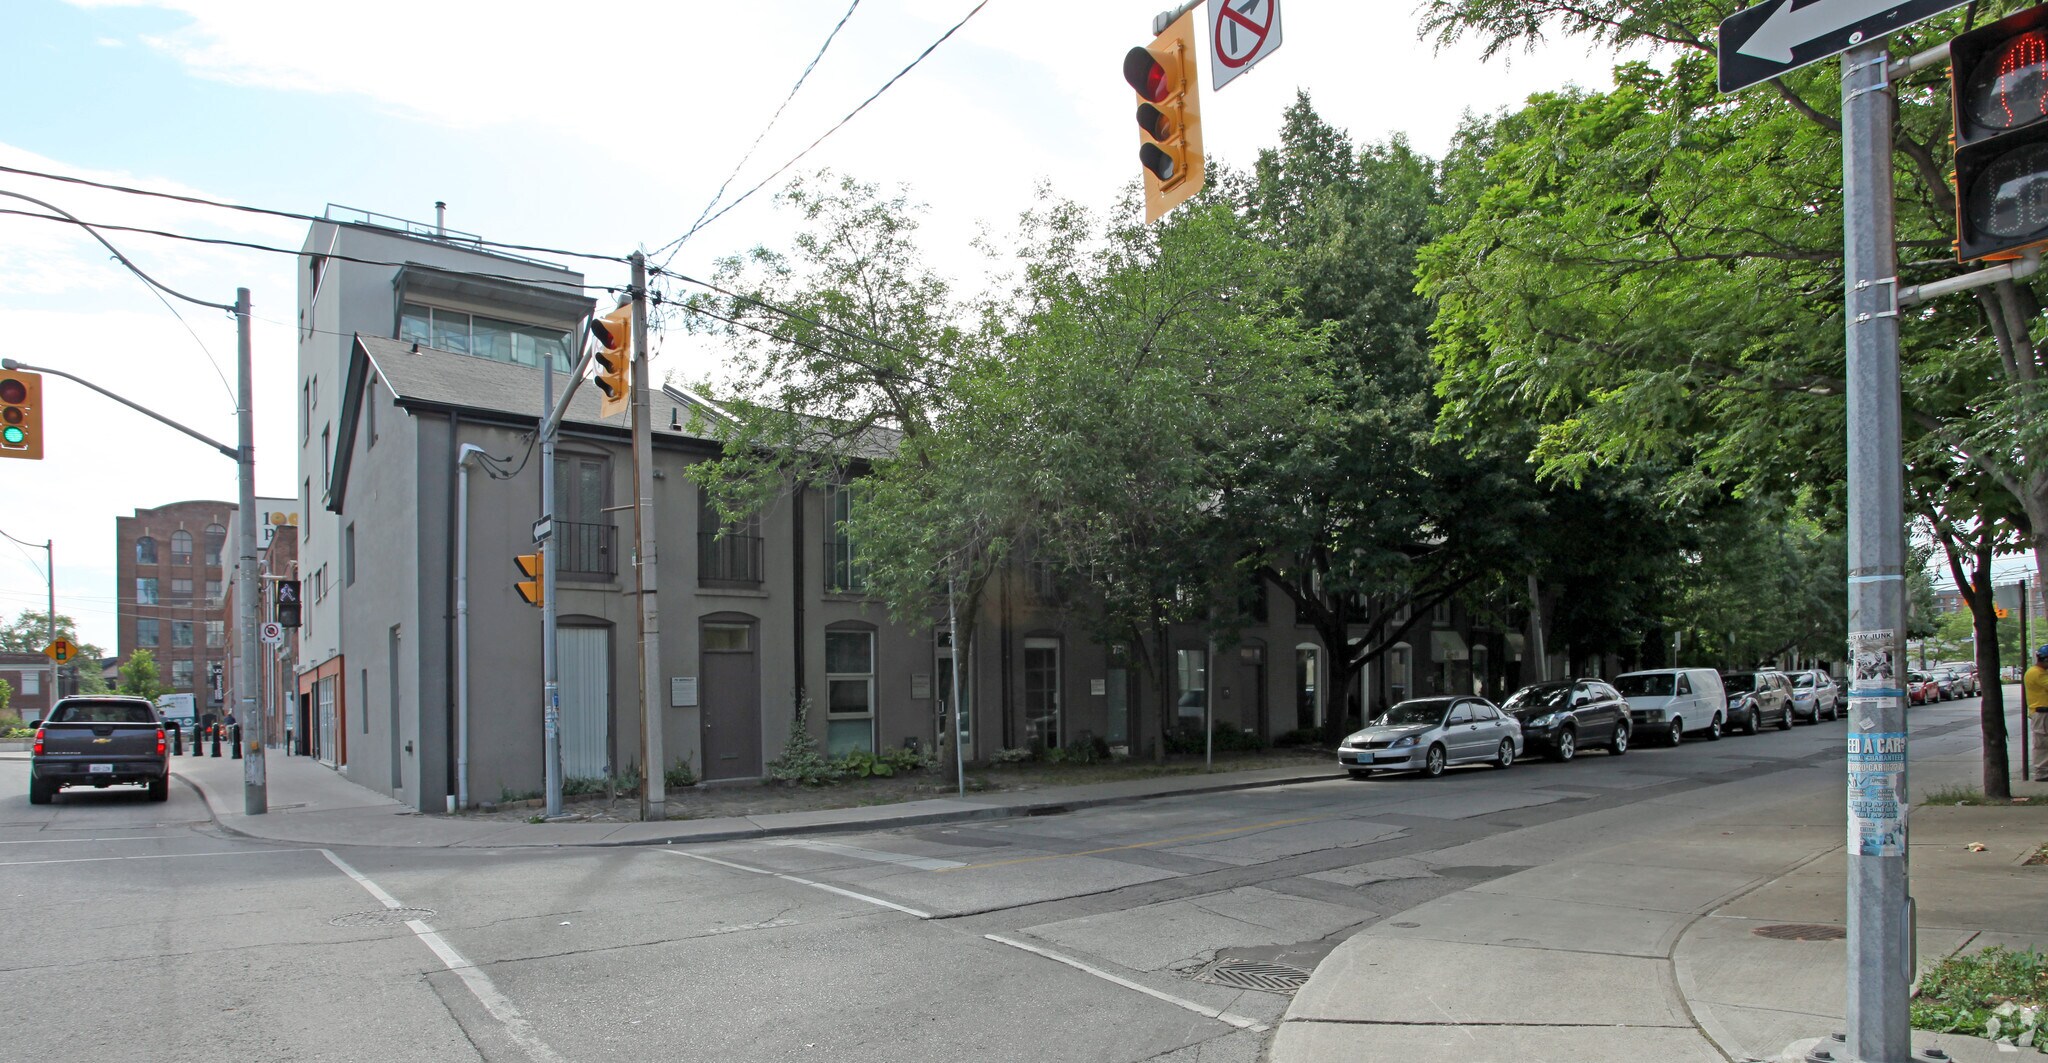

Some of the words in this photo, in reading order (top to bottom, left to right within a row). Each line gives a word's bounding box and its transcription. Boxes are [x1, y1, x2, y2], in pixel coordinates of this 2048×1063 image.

[1871, 632, 1891, 640] JUNK
[1848, 738, 1861, 754] EED
[1863, 738, 1874, 754] A
[1877, 737, 1906, 754] CAR?
